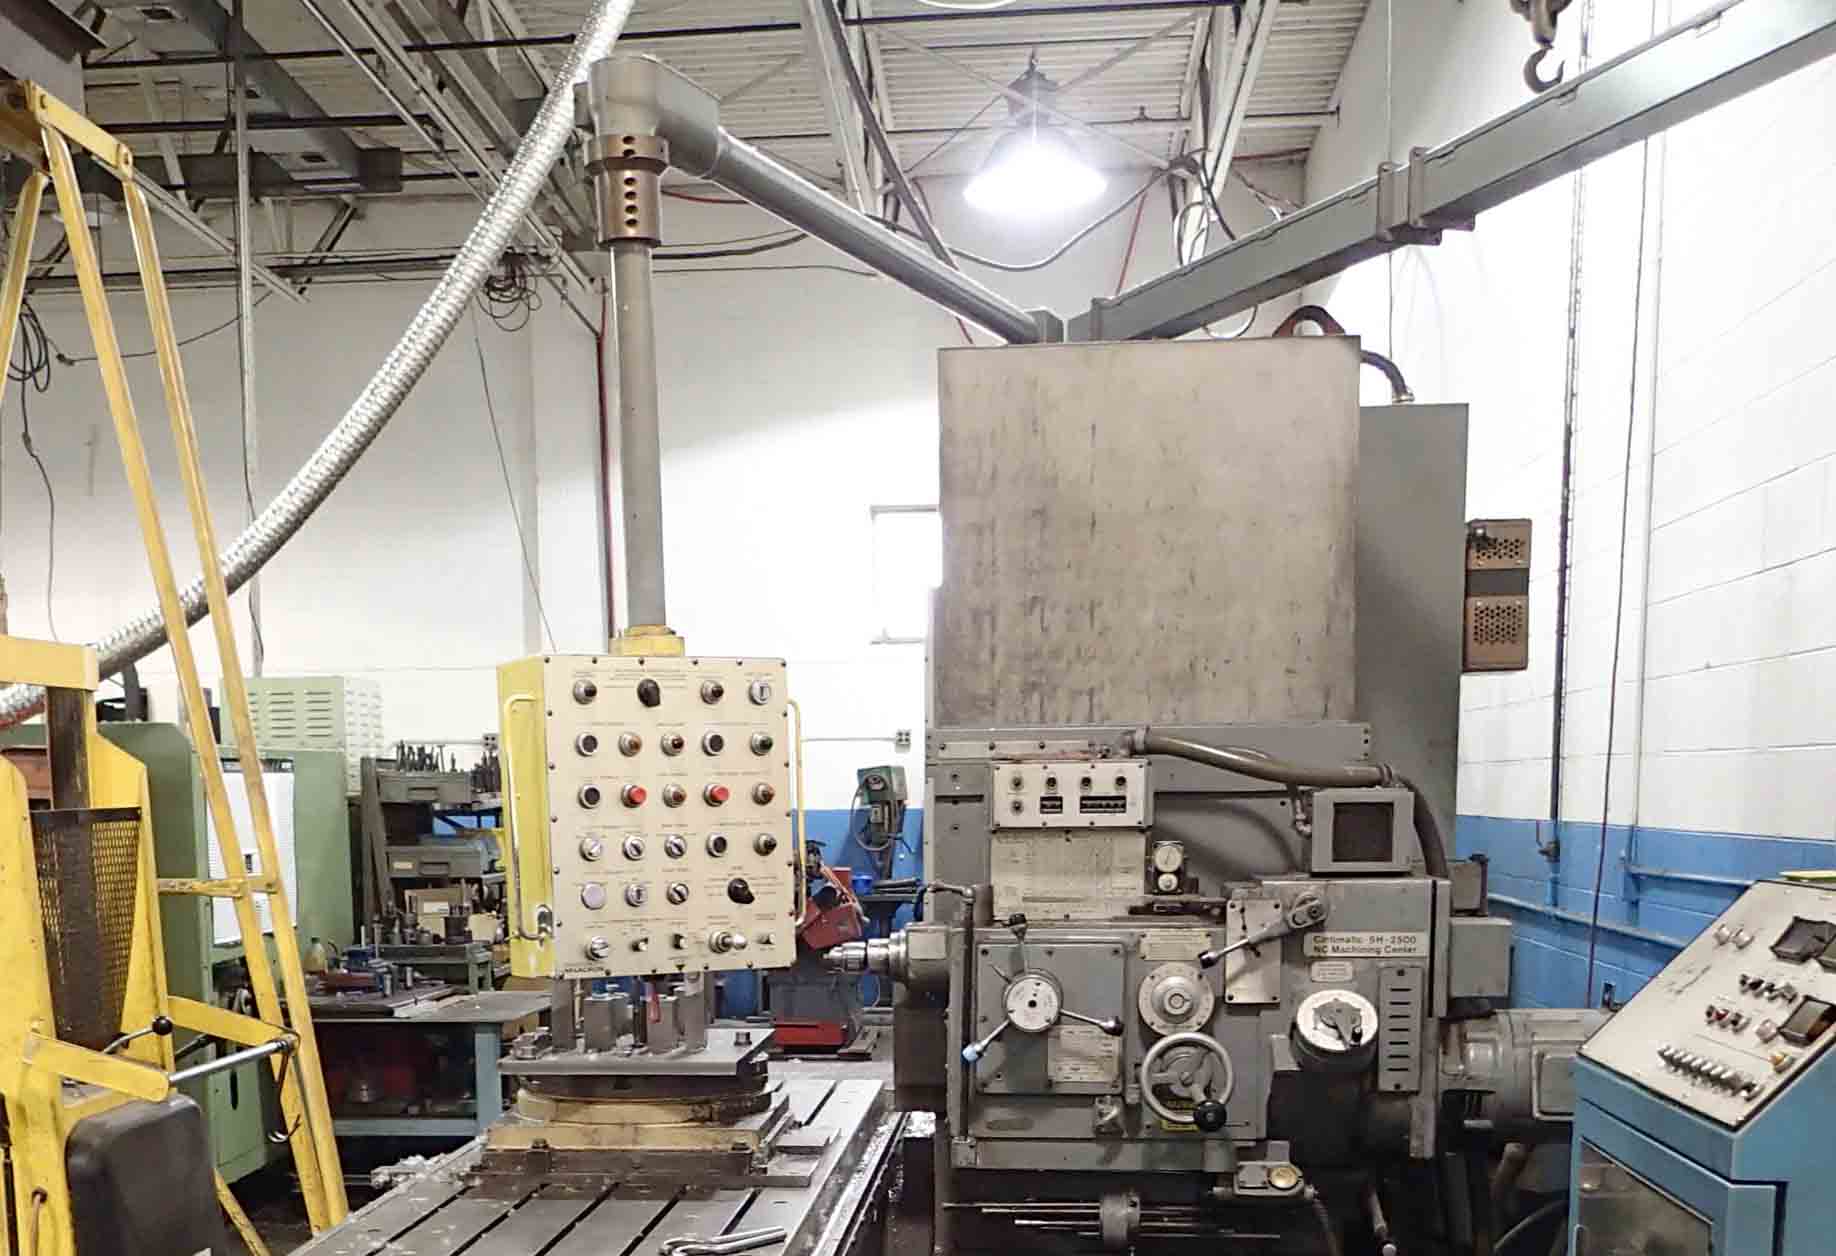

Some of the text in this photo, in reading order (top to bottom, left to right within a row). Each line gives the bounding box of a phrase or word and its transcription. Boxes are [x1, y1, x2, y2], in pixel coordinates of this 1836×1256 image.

[1313, 945, 1417, 955] NC Machining Center
